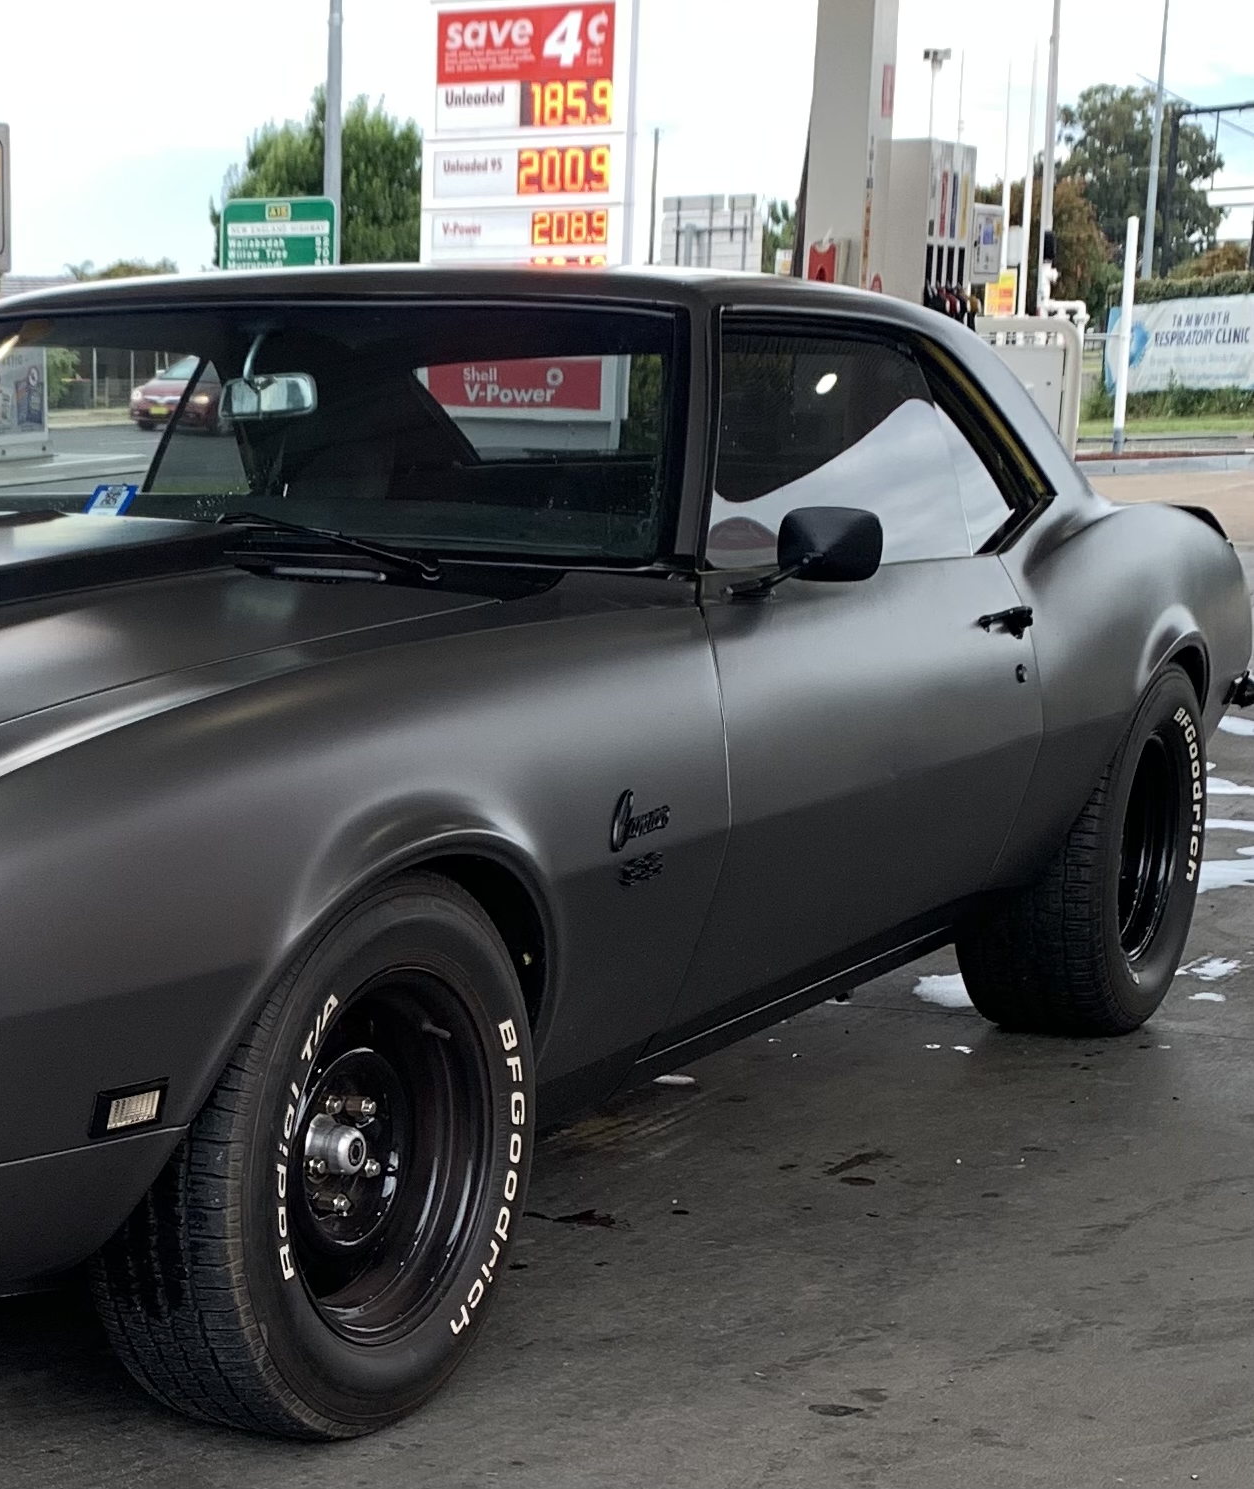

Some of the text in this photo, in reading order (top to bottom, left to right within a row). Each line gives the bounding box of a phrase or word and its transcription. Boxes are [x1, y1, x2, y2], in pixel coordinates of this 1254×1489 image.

[445, 18, 534, 50] save
[445, 87, 505, 108] Unleaded
[443, 158, 488, 174] Unleaded
[491, 157, 503, 173] 95
[442, 222, 482, 237] V-Power
[1173, 312, 1230, 327] TAMWORTH
[1154, 327, 1250, 346] RESPIRATORY CLINIC
[463, 366, 497, 382] Shell
[464, 384, 555, 403] V-Power
[1173, 707, 1203, 882] BFGoodrich
[276, 994, 339, 1281] Radial T/A
[450, 1019, 526, 1335] BFGoodrich
